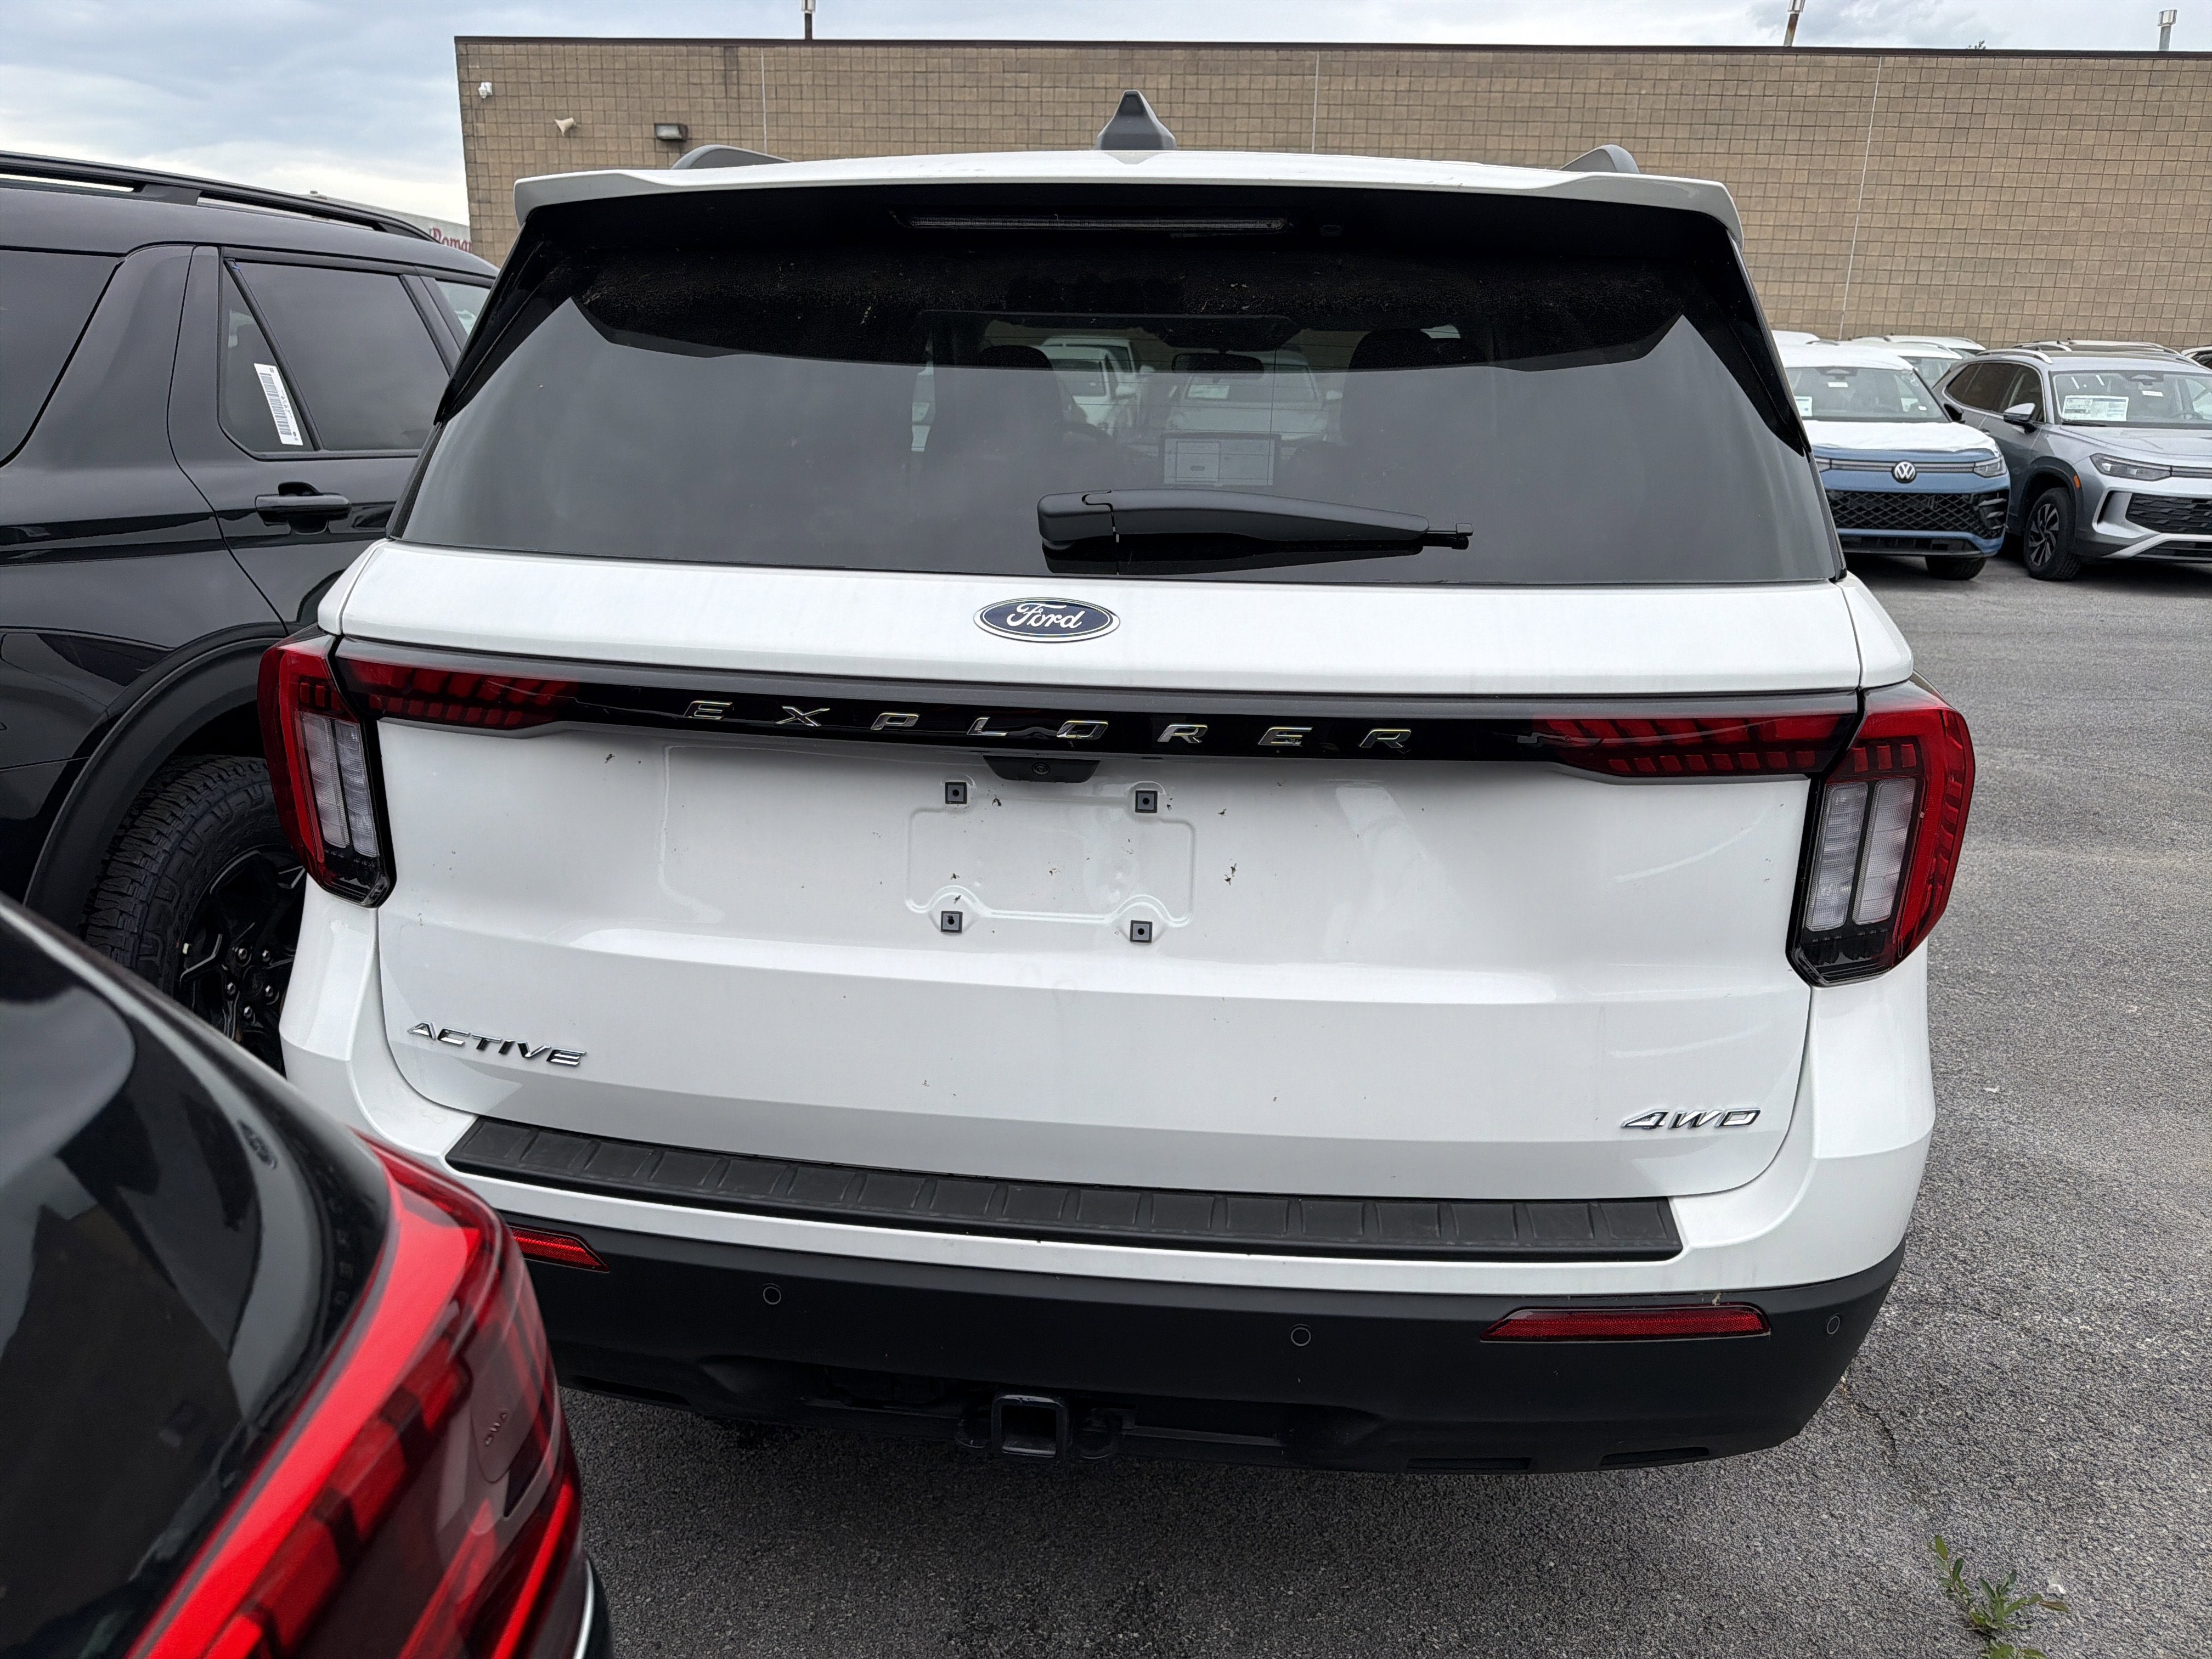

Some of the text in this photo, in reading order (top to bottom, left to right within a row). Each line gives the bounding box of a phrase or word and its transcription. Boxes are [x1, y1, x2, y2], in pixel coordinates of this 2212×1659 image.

[1006, 602, 1086, 629] Ford
[683, 700, 1412, 748] EXPLORER
[407, 1021, 588, 1066] ACTIVE
[1620, 1108, 1761, 1129] 4WD
